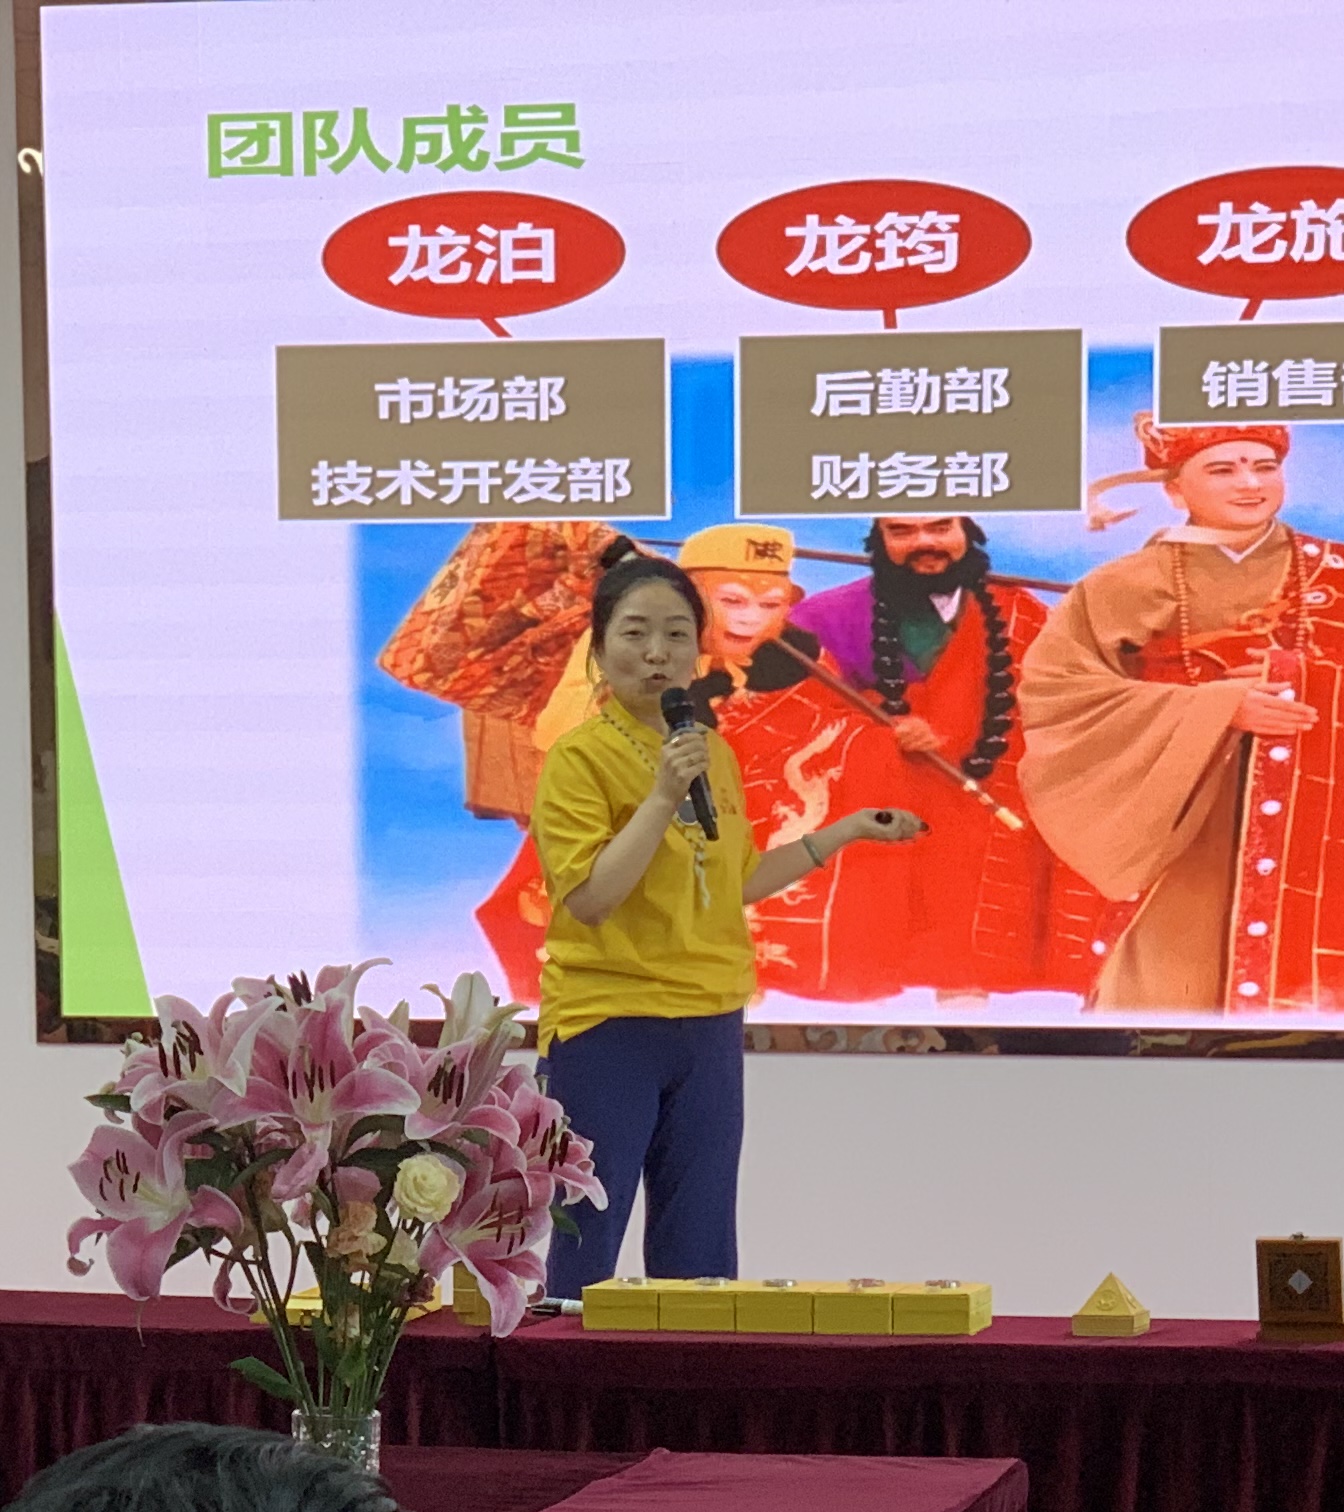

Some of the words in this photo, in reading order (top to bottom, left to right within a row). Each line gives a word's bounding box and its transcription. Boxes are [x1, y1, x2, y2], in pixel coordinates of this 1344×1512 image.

[206, 102, 585, 178] 团队成员
[387, 222, 558, 287] 龙泊
[784, 209, 961, 277] 龙筠
[374, 375, 567, 424] 市场部
[810, 366, 1010, 418] 后勤部
[311, 456, 632, 507] 技术开发部
[810, 450, 1010, 500] 财务部
